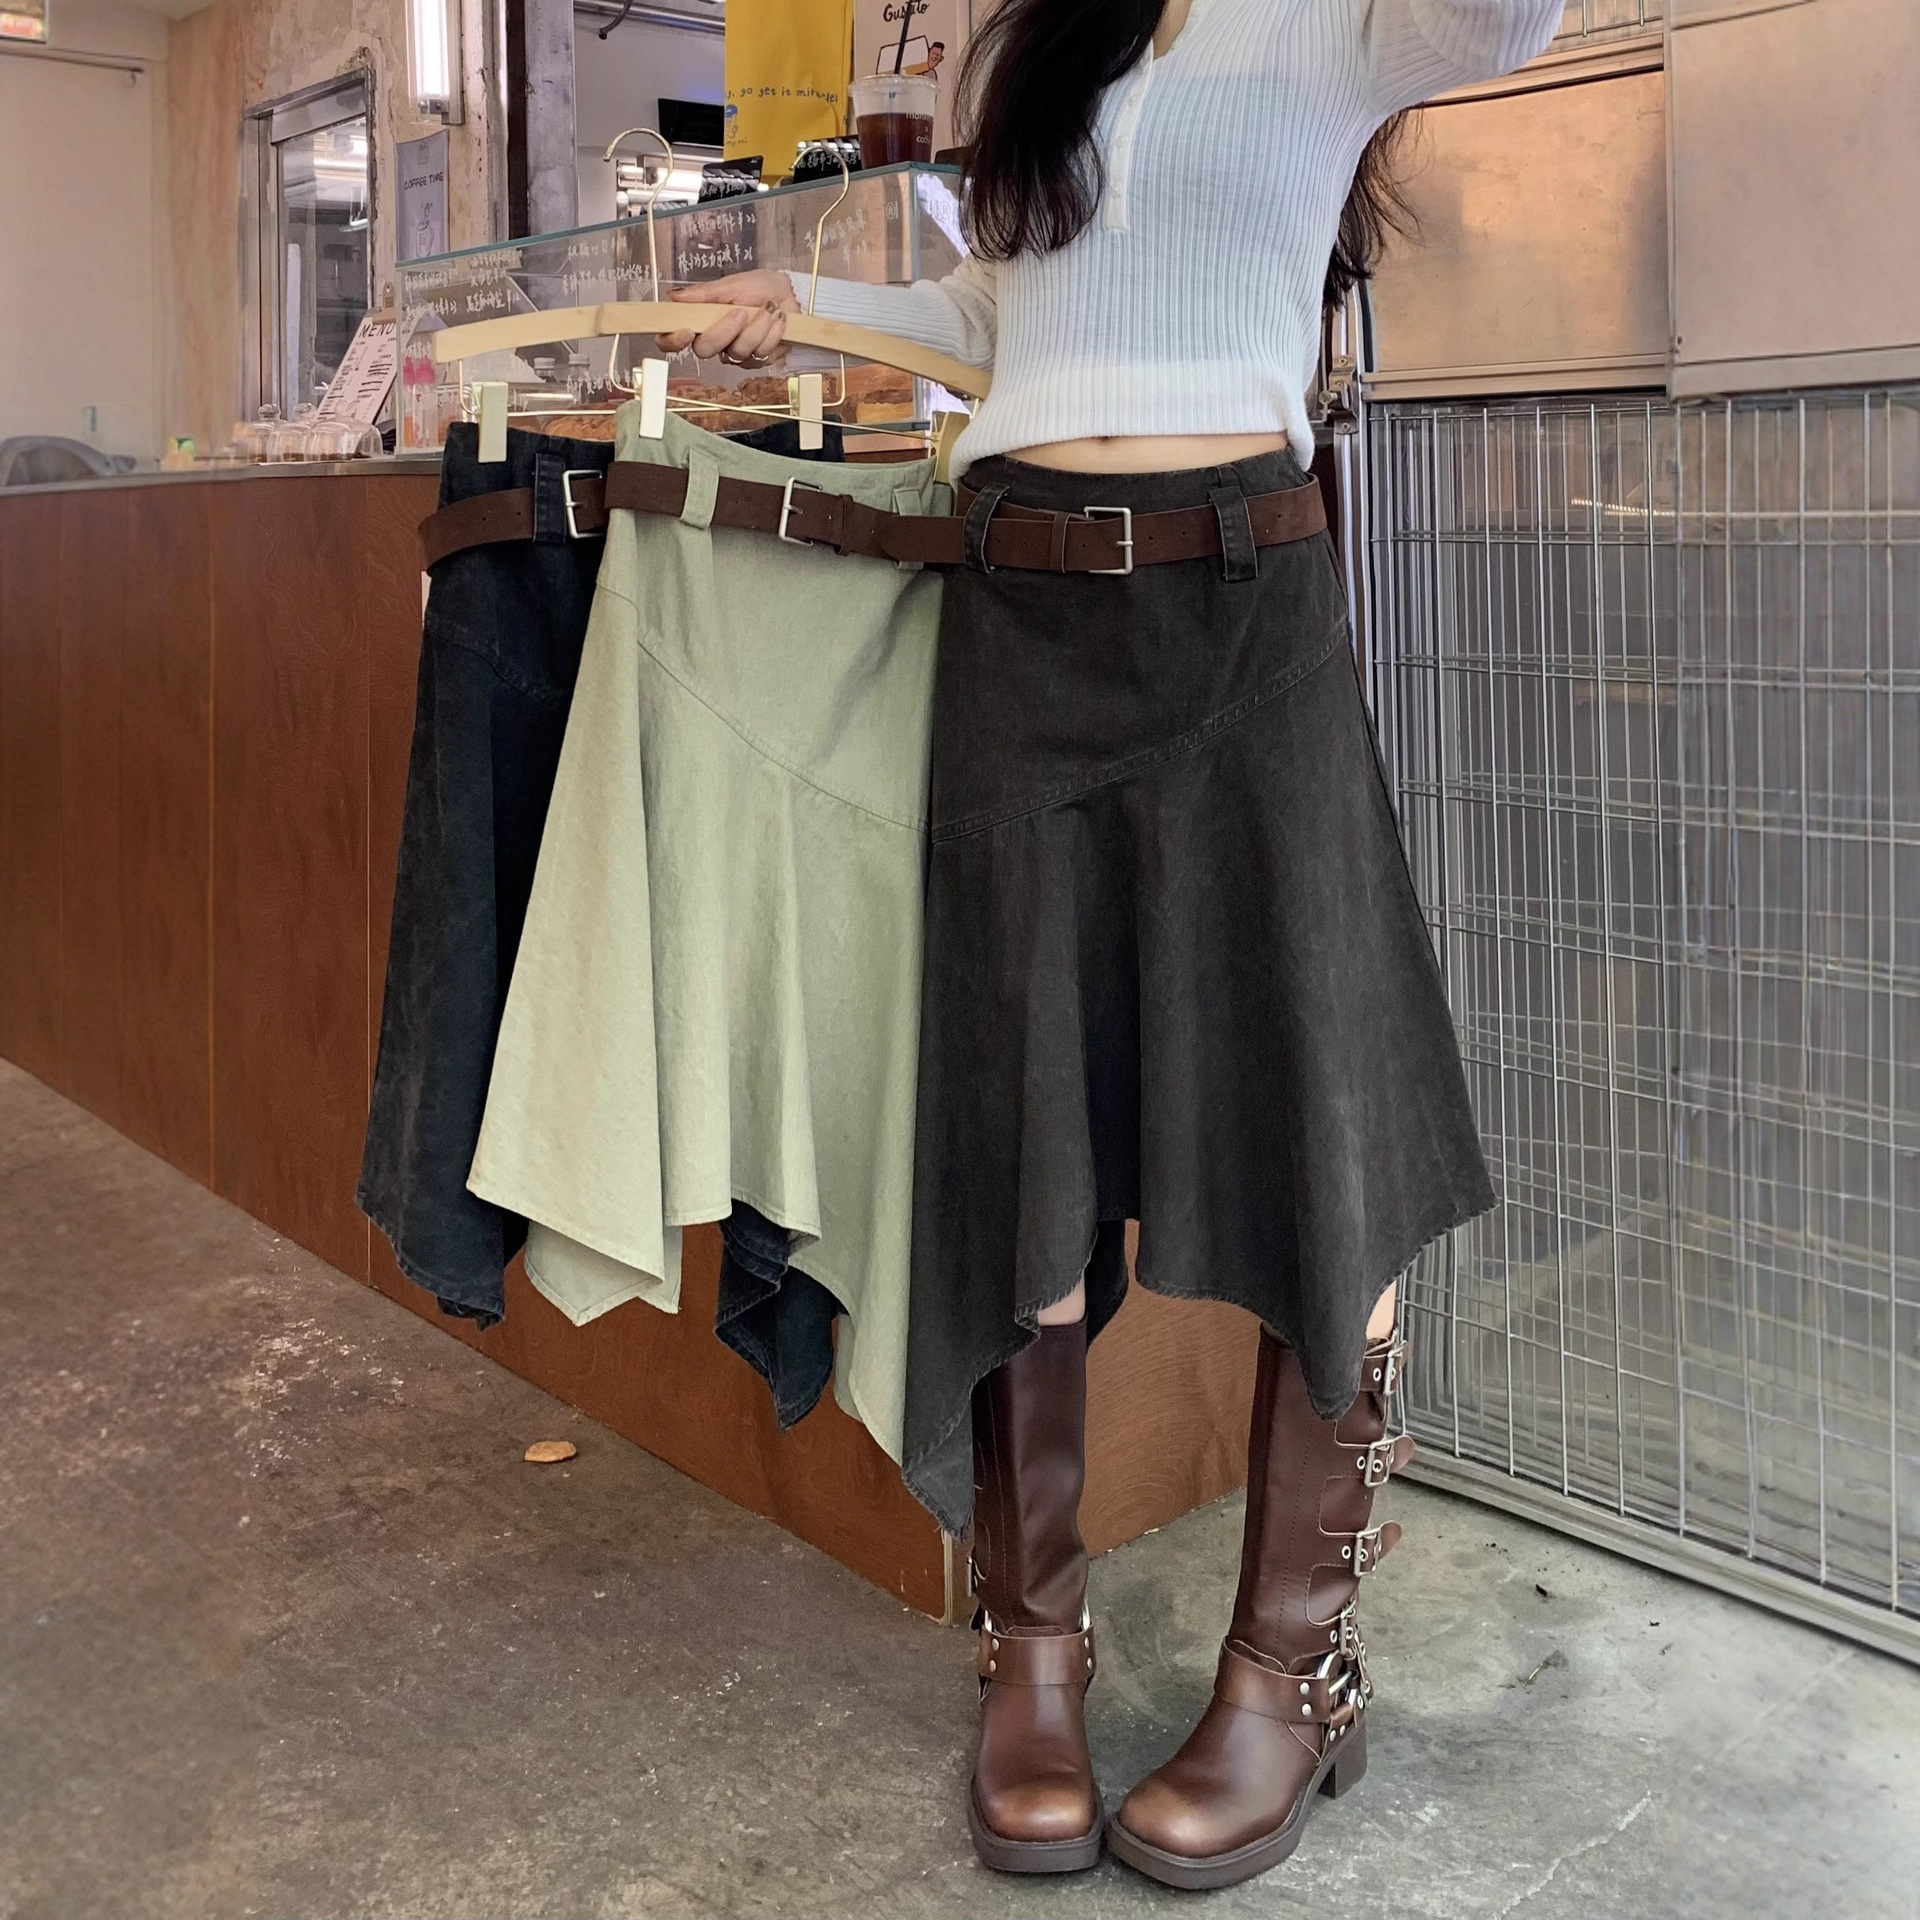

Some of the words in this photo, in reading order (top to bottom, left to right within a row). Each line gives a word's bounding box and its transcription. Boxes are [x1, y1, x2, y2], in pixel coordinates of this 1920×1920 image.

[740, 87, 753, 97] go
[758, 86, 777, 97] get
[781, 86, 792, 96] it
[404, 175, 428, 190] COFFEE
[428, 171, 444, 184] TIME
[359, 322, 397, 338] MENU
